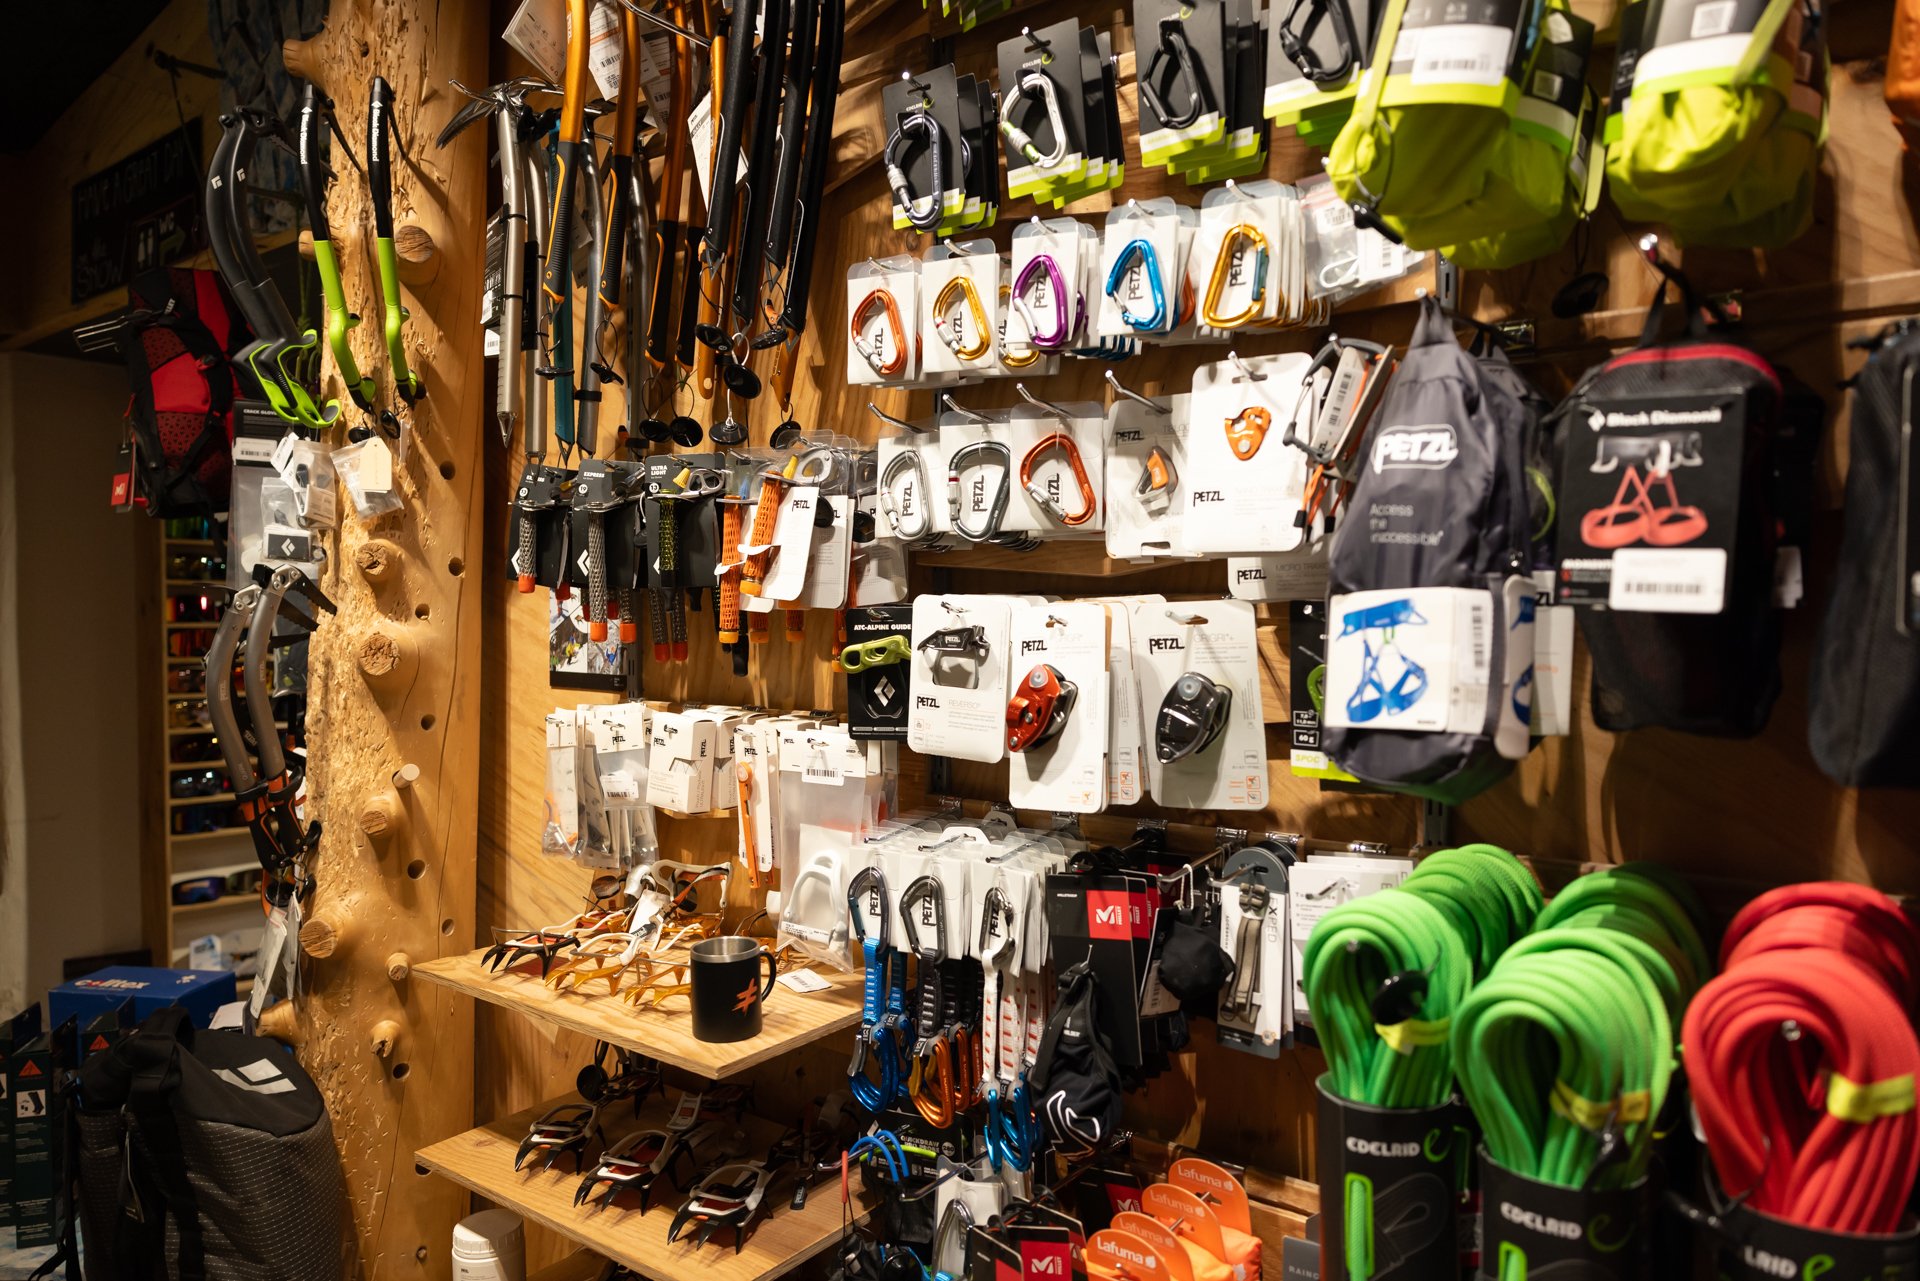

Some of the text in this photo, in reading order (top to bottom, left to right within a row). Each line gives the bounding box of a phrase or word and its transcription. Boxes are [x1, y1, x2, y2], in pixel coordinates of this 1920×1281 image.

[372, 108, 380, 162] Black Diamond
[1230, 246, 1246, 288] PETZL
[1606, 409, 1722, 427] Black Diamond
[1116, 430, 1144, 447] PETZL
[1374, 431, 1459, 475] PETZL
[902, 480, 914, 518] PETZL
[972, 474, 988, 513] PETZL
[1193, 490, 1225, 507] PETZL
[792, 500, 810, 512] PETZL
[1370, 504, 1414, 517] Access
[1237, 569, 1267, 584] PETZL
[1021, 639, 1048, 656] PETZL
[1148, 638, 1185, 655] PETZL
[916, 696, 940, 710] PETZL
[612, 735, 626, 745] PETZL
[922, 889, 938, 926] PETZL
[1270, 897, 1280, 944] EXPED
[1346, 1136, 1421, 1158] EDELRID
[1178, 1164, 1222, 1188] Lafuma
[1150, 1190, 1194, 1215] Lafuma
[1119, 1218, 1163, 1244] Lafuma
[1500, 1202, 1582, 1240] EDELRID
[1096, 1236, 1144, 1266] Lafuma
